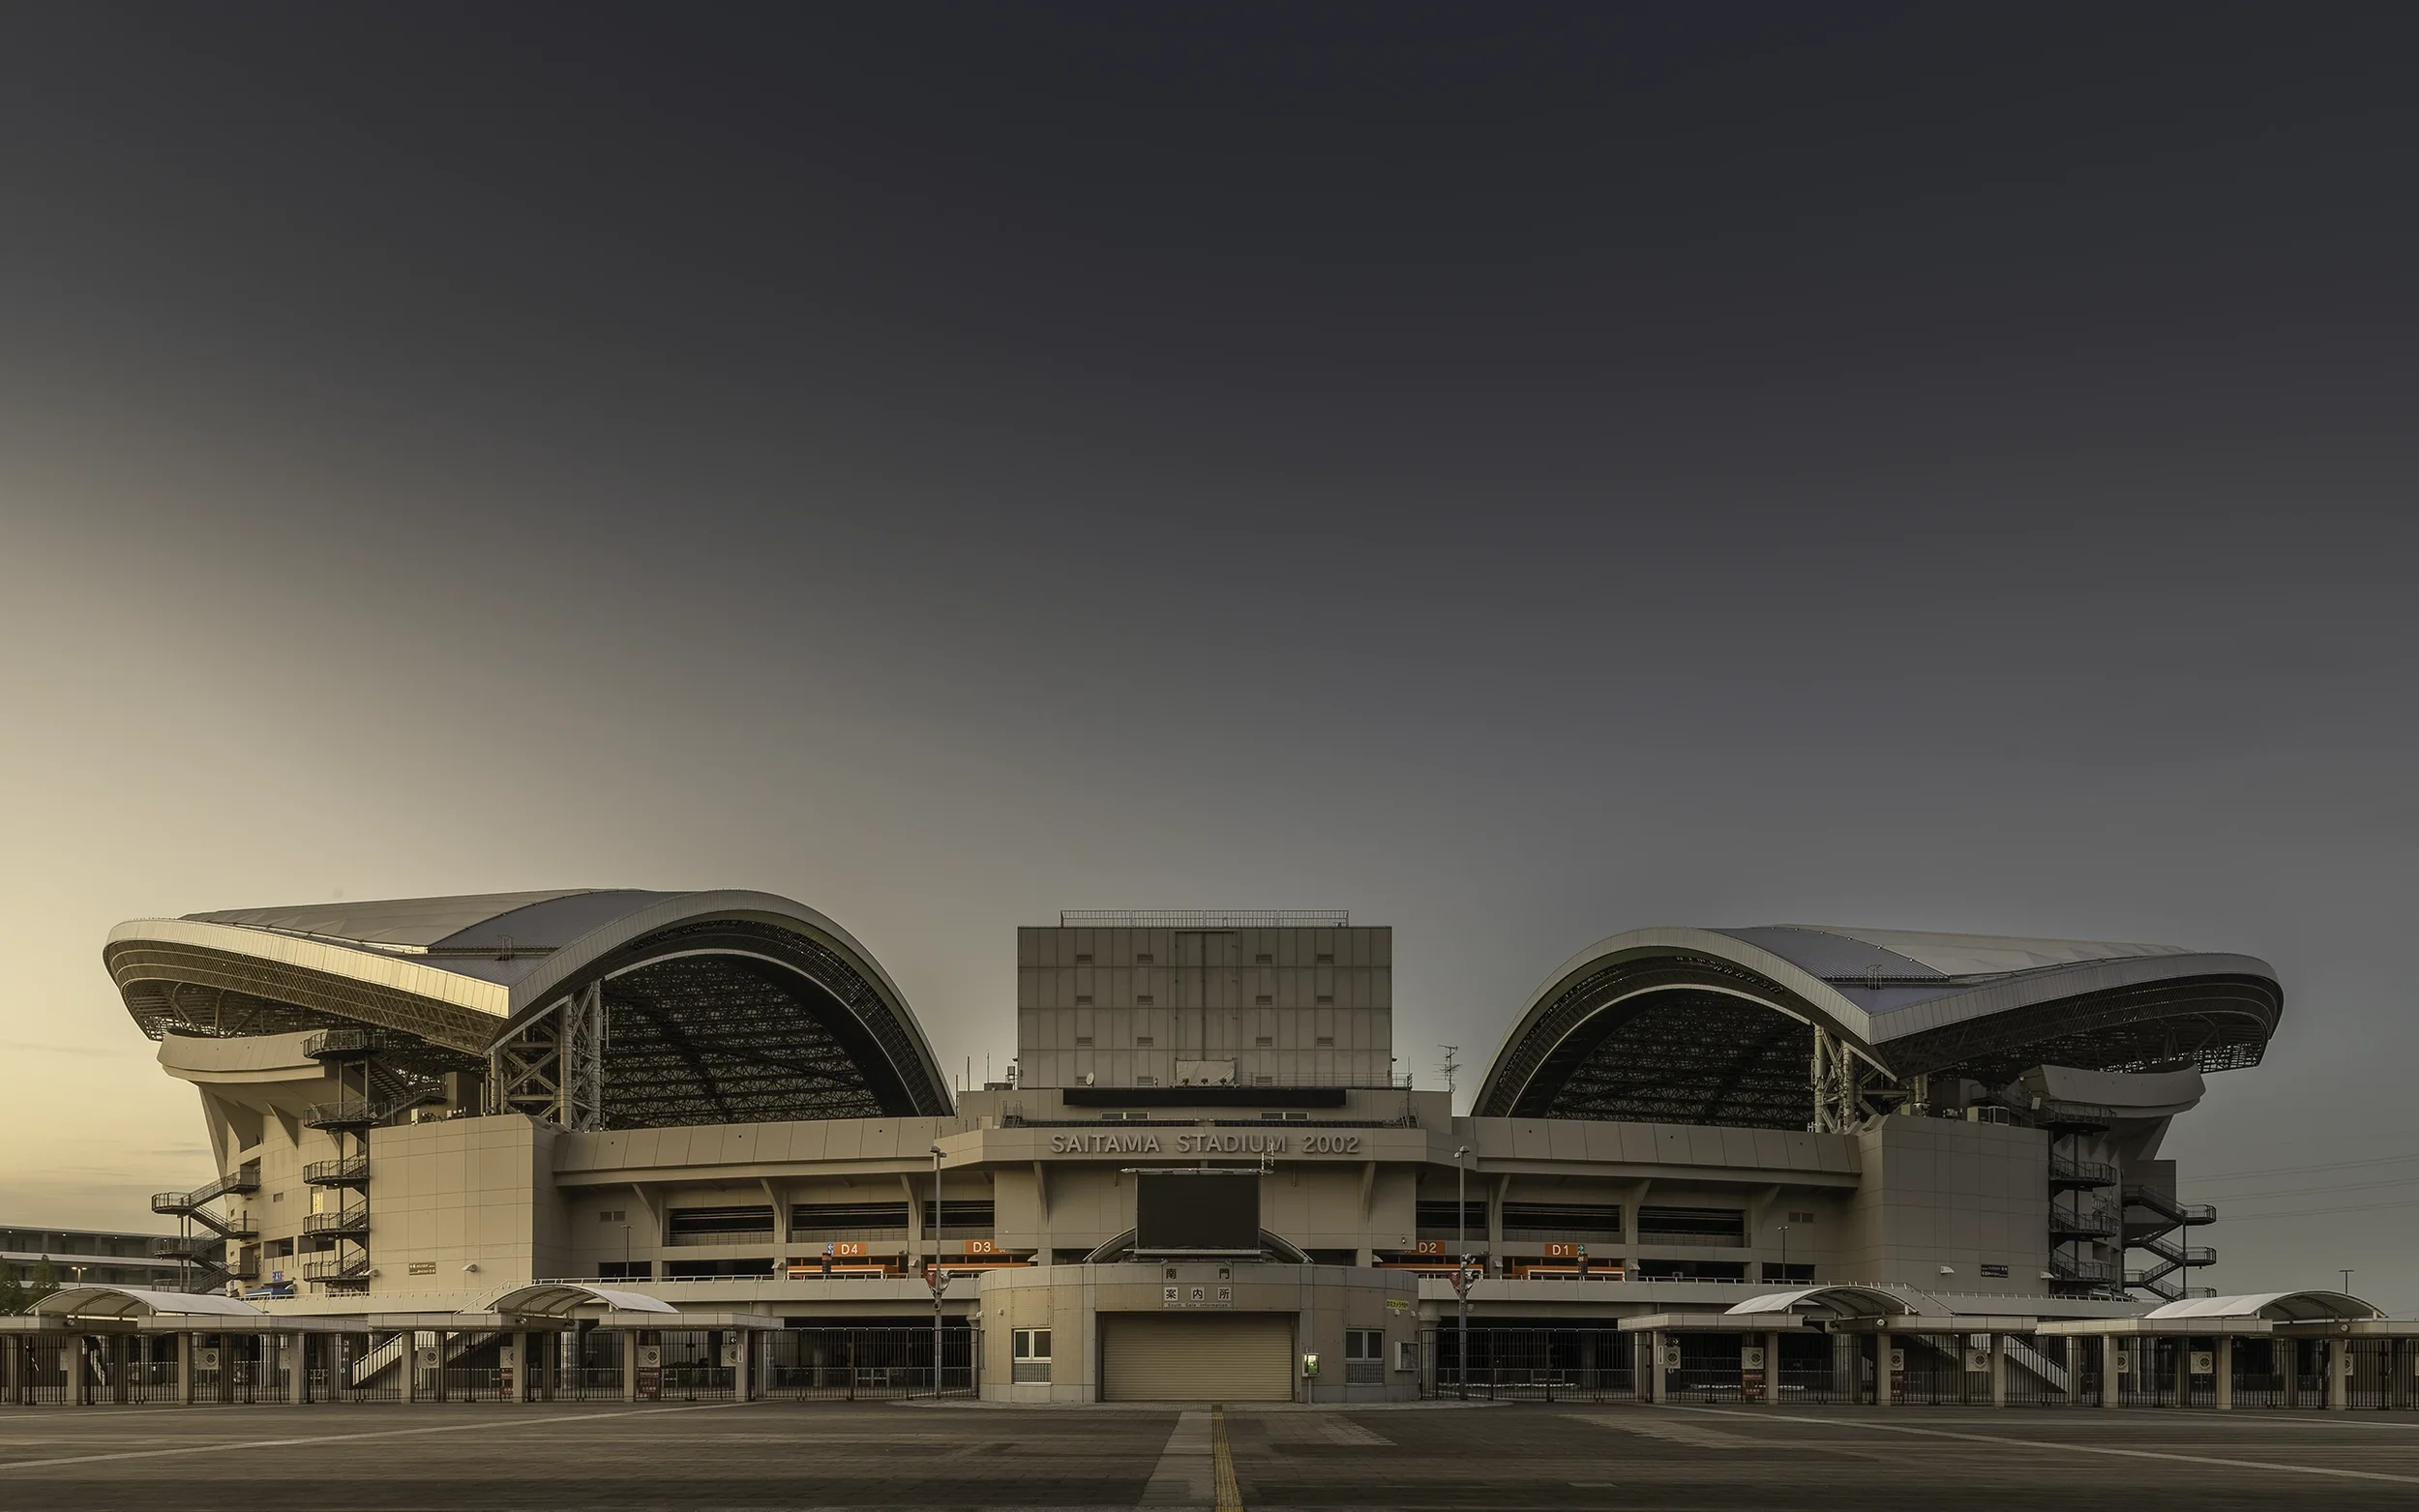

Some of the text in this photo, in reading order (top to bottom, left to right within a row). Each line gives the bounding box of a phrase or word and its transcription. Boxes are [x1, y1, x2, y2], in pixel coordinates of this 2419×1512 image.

[1050, 1134, 1360, 1154] SAITAMA STADIUM 2002
[841, 1243, 858, 1255] D4
[972, 1241, 991, 1253] D3
[1419, 1242, 1437, 1254] D2
[1552, 1244, 1568, 1256] D1
